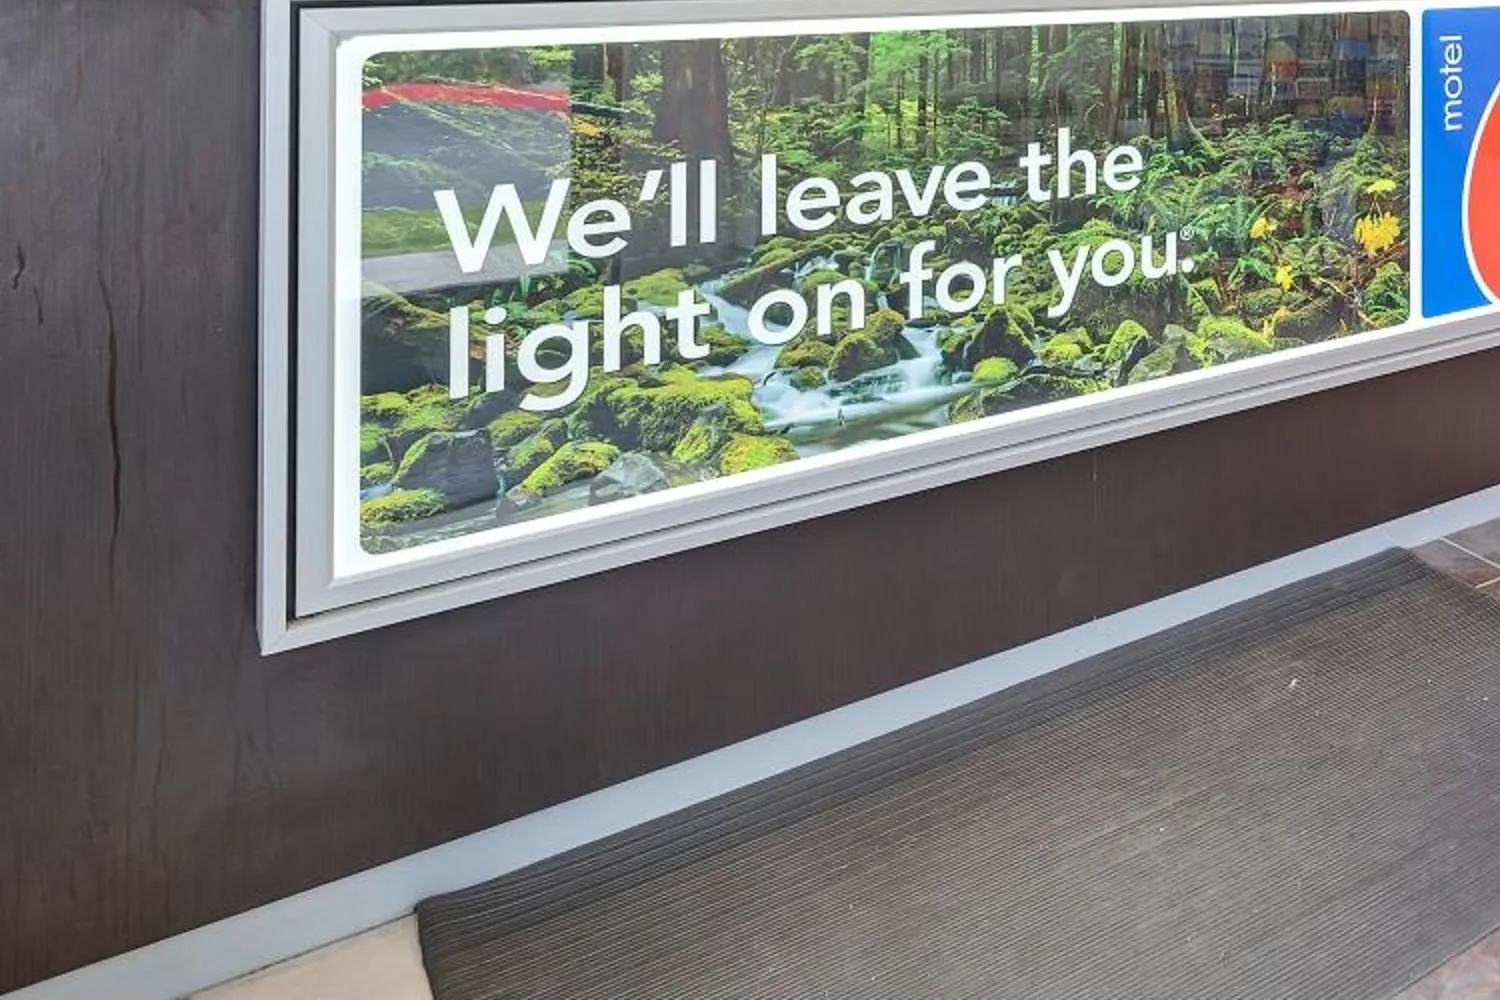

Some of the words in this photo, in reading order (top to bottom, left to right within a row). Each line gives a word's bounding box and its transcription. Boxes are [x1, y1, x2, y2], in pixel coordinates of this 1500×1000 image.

[1439, 34, 1464, 132] motel
[433, 157, 717, 274] We'll
[761, 153, 990, 237] leave
[1019, 128, 1144, 203] the
[448, 275, 712, 412] light
[749, 278, 865, 346] on
[901, 240, 1023, 320] for
